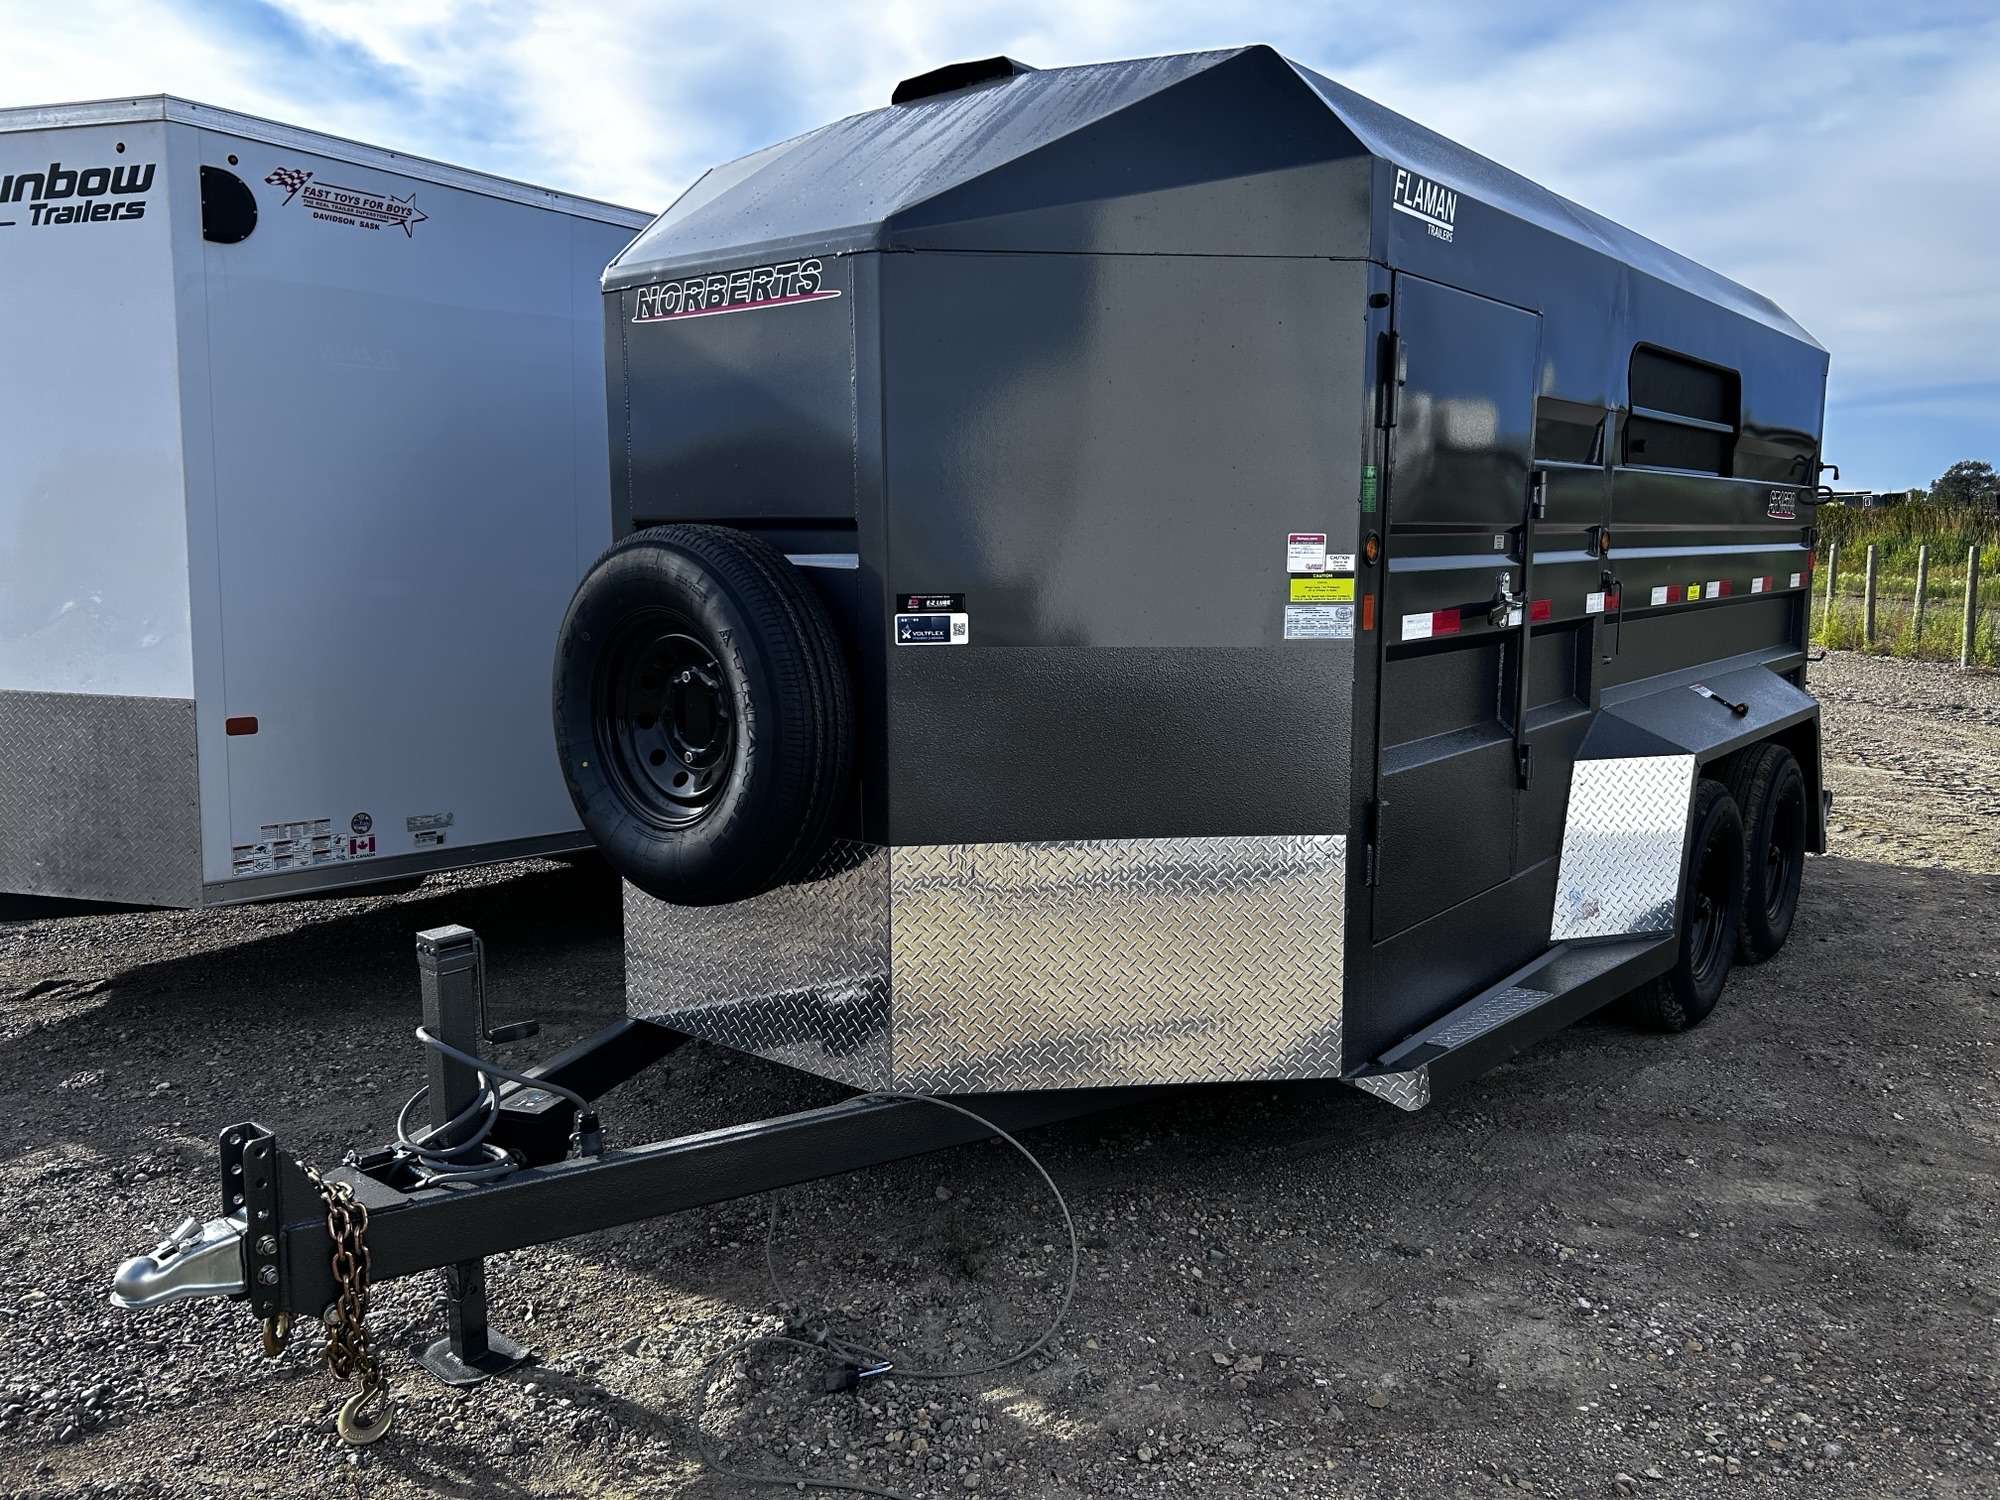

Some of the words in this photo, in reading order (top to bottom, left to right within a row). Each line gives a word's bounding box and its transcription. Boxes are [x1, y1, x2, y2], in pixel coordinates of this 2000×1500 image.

[303, 186, 332, 199] FAST
[334, 192, 360, 206] TOYS
[363, 199, 384, 210] FOR
[386, 203, 413, 216] BOYS
[1393, 168, 1457, 223] FLAMAN
[29, 200, 147, 226] Trailers
[312, 211, 355, 226] DAVIDSON
[359, 220, 380, 230] SASK
[1427, 223, 1453, 243] TRAILERS
[633, 259, 823, 320] NORBERTS
